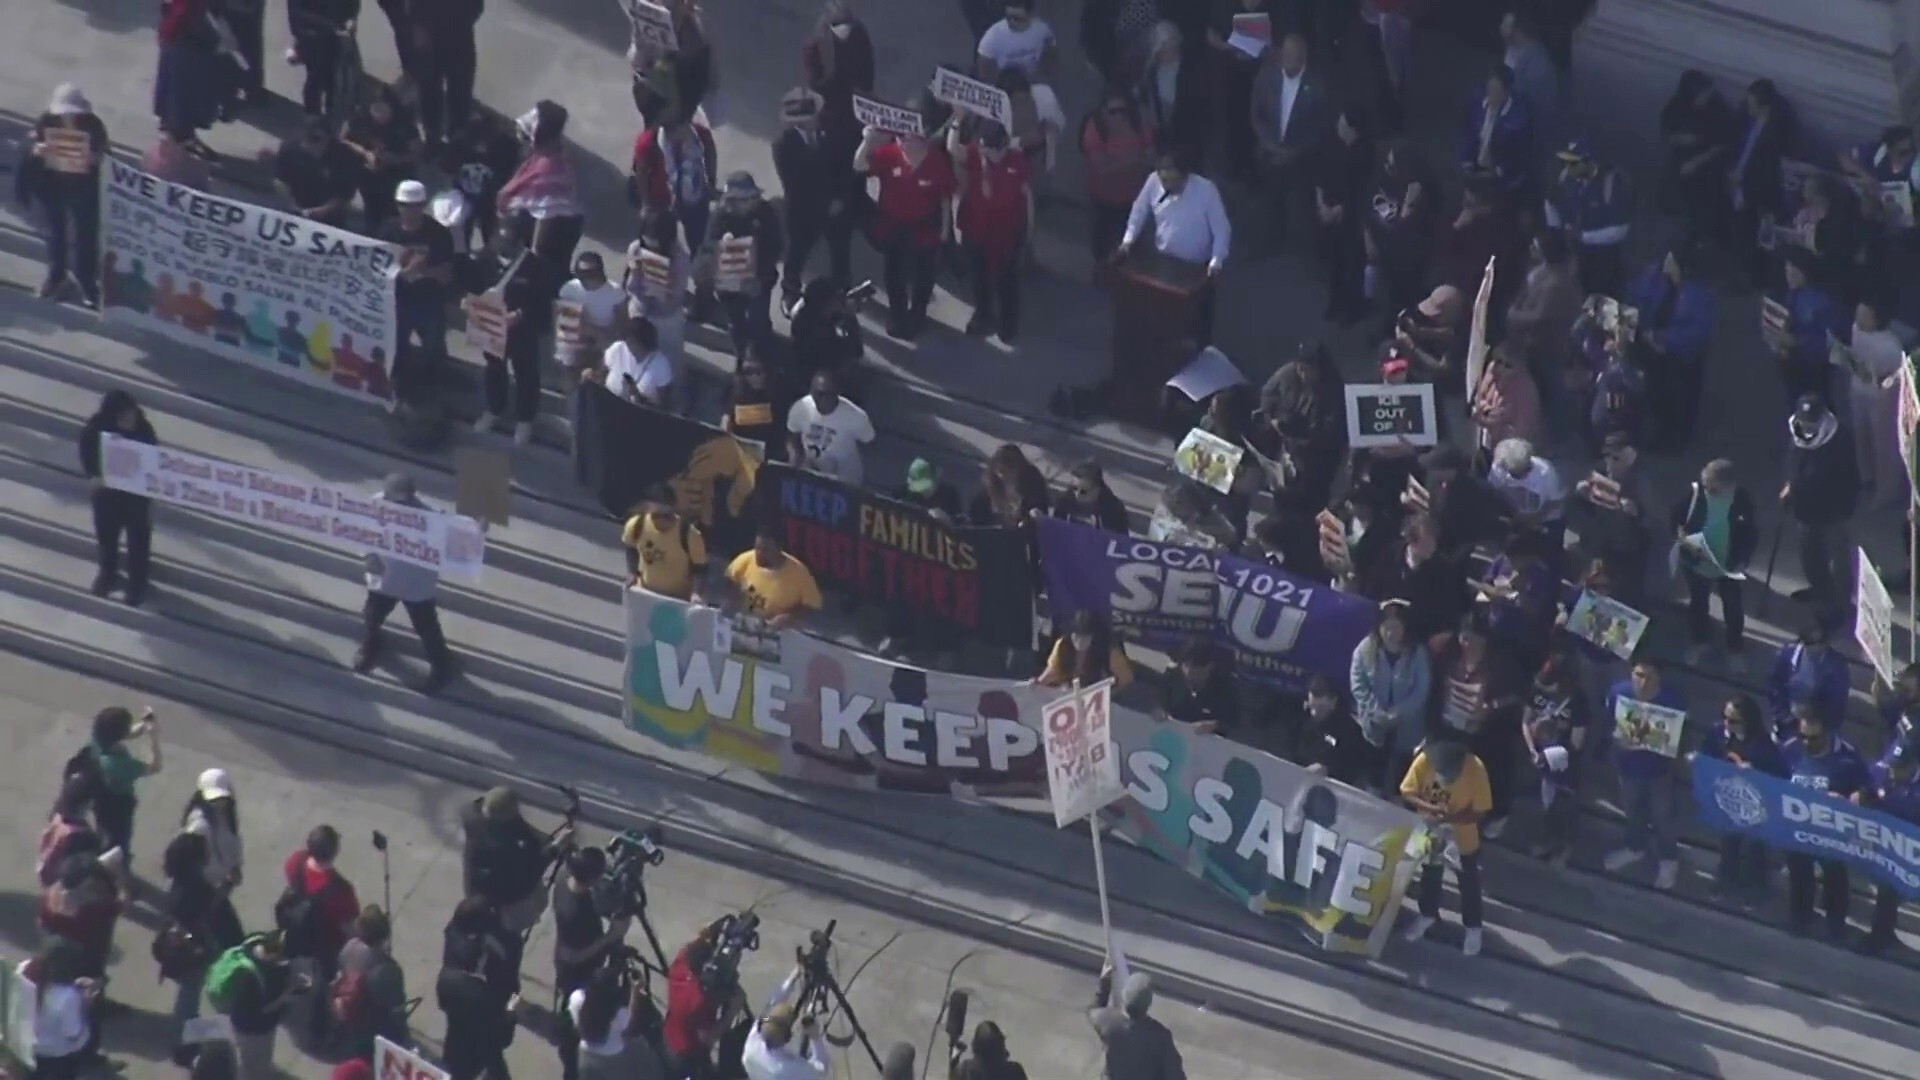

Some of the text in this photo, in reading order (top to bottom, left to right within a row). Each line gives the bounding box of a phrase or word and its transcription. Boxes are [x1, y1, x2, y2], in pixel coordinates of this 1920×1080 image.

[111, 161, 395, 279] WE KEEP US SAFE!
[1375, 407, 1407, 419] OUT
[216, 466, 243, 487] and
[310, 486, 334, 508] All
[337, 492, 427, 533] Immigrants
[782, 479, 979, 571] KEEP FAMILIES
[394, 532, 440, 566] Strike
[1106, 539, 1315, 608] LOCAL 1021
[1109, 562, 1307, 653] SEIU
[655, 639, 792, 738] WE
[819, 687, 1038, 772] KEEP
[1188, 777, 1385, 916] SAFE
